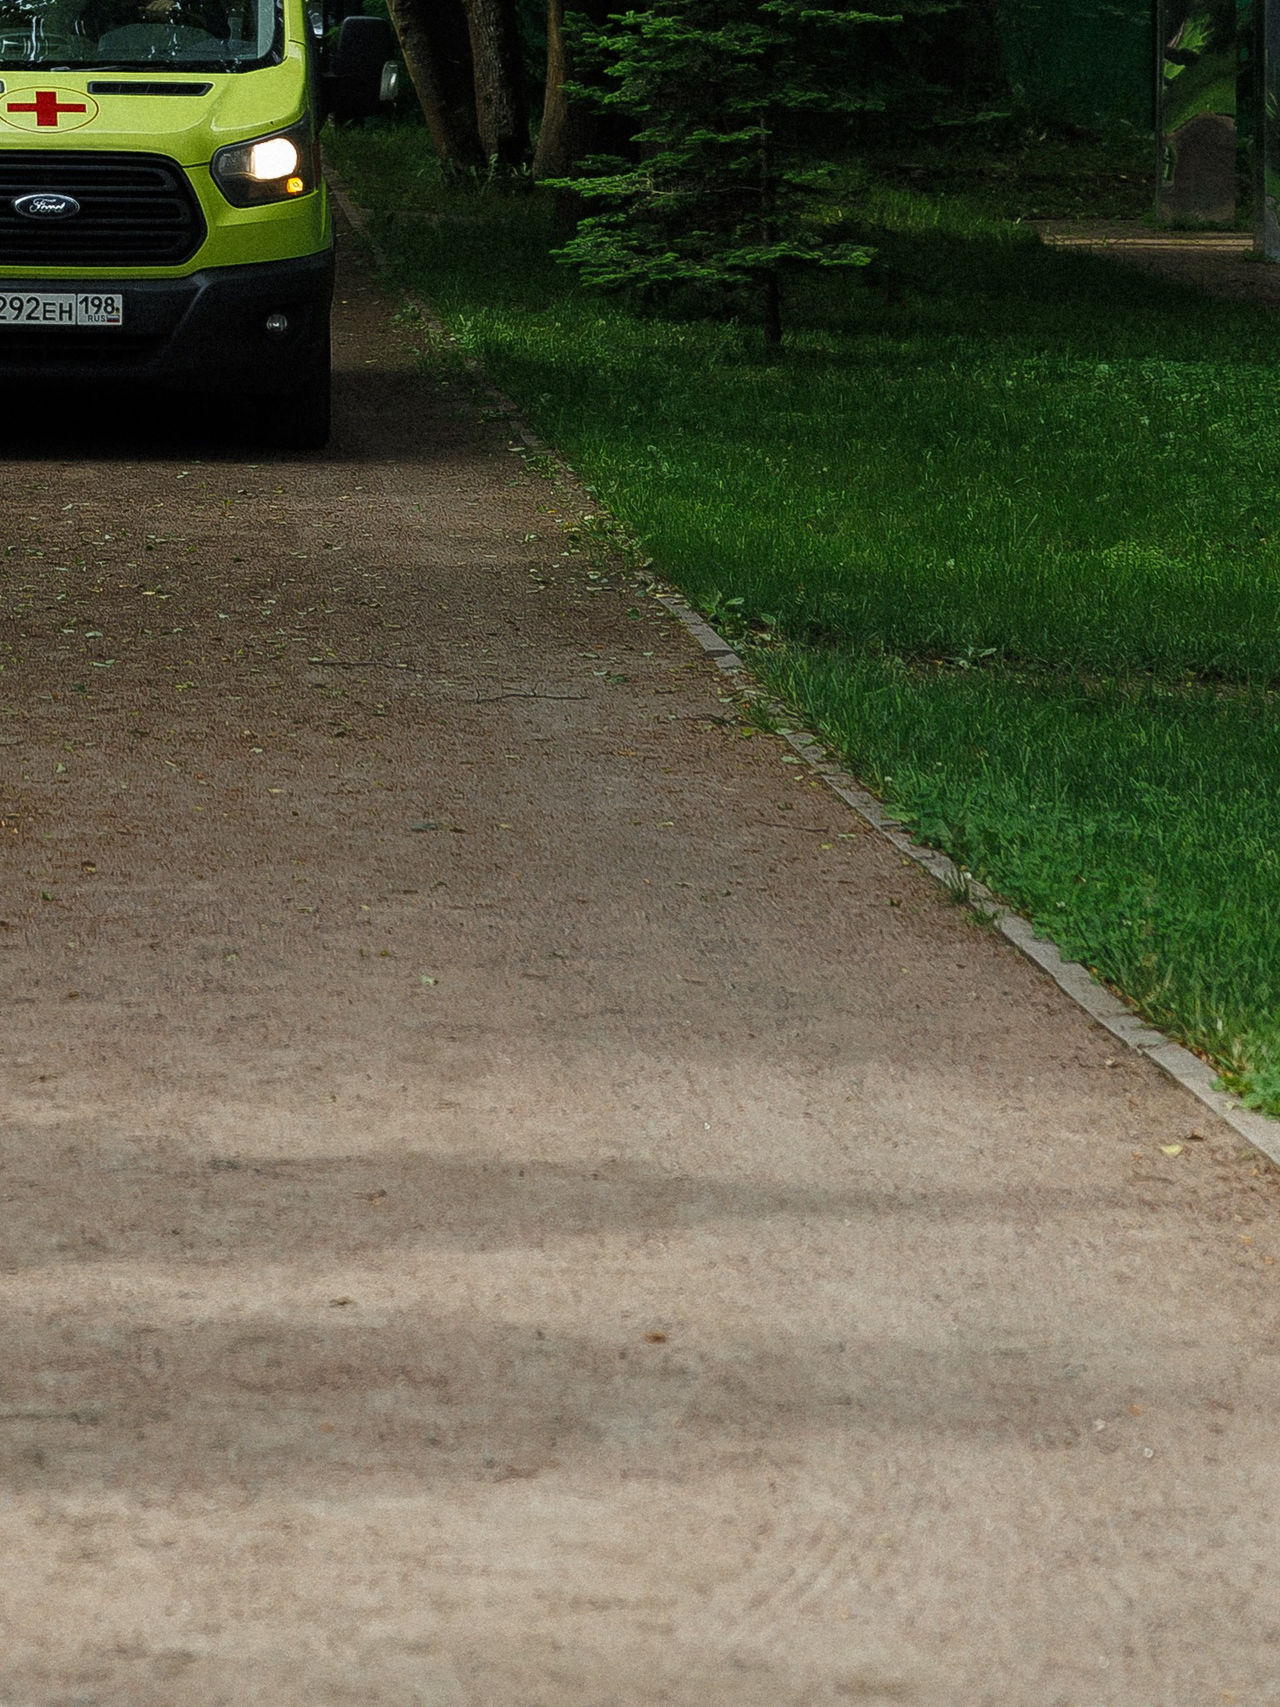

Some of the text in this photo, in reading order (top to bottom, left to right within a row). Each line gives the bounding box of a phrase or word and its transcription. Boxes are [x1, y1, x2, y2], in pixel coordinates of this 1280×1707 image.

[29, 198, 66, 214] Ford
[79, 295, 116, 315] 198
[87, 314, 106, 323] RUS
